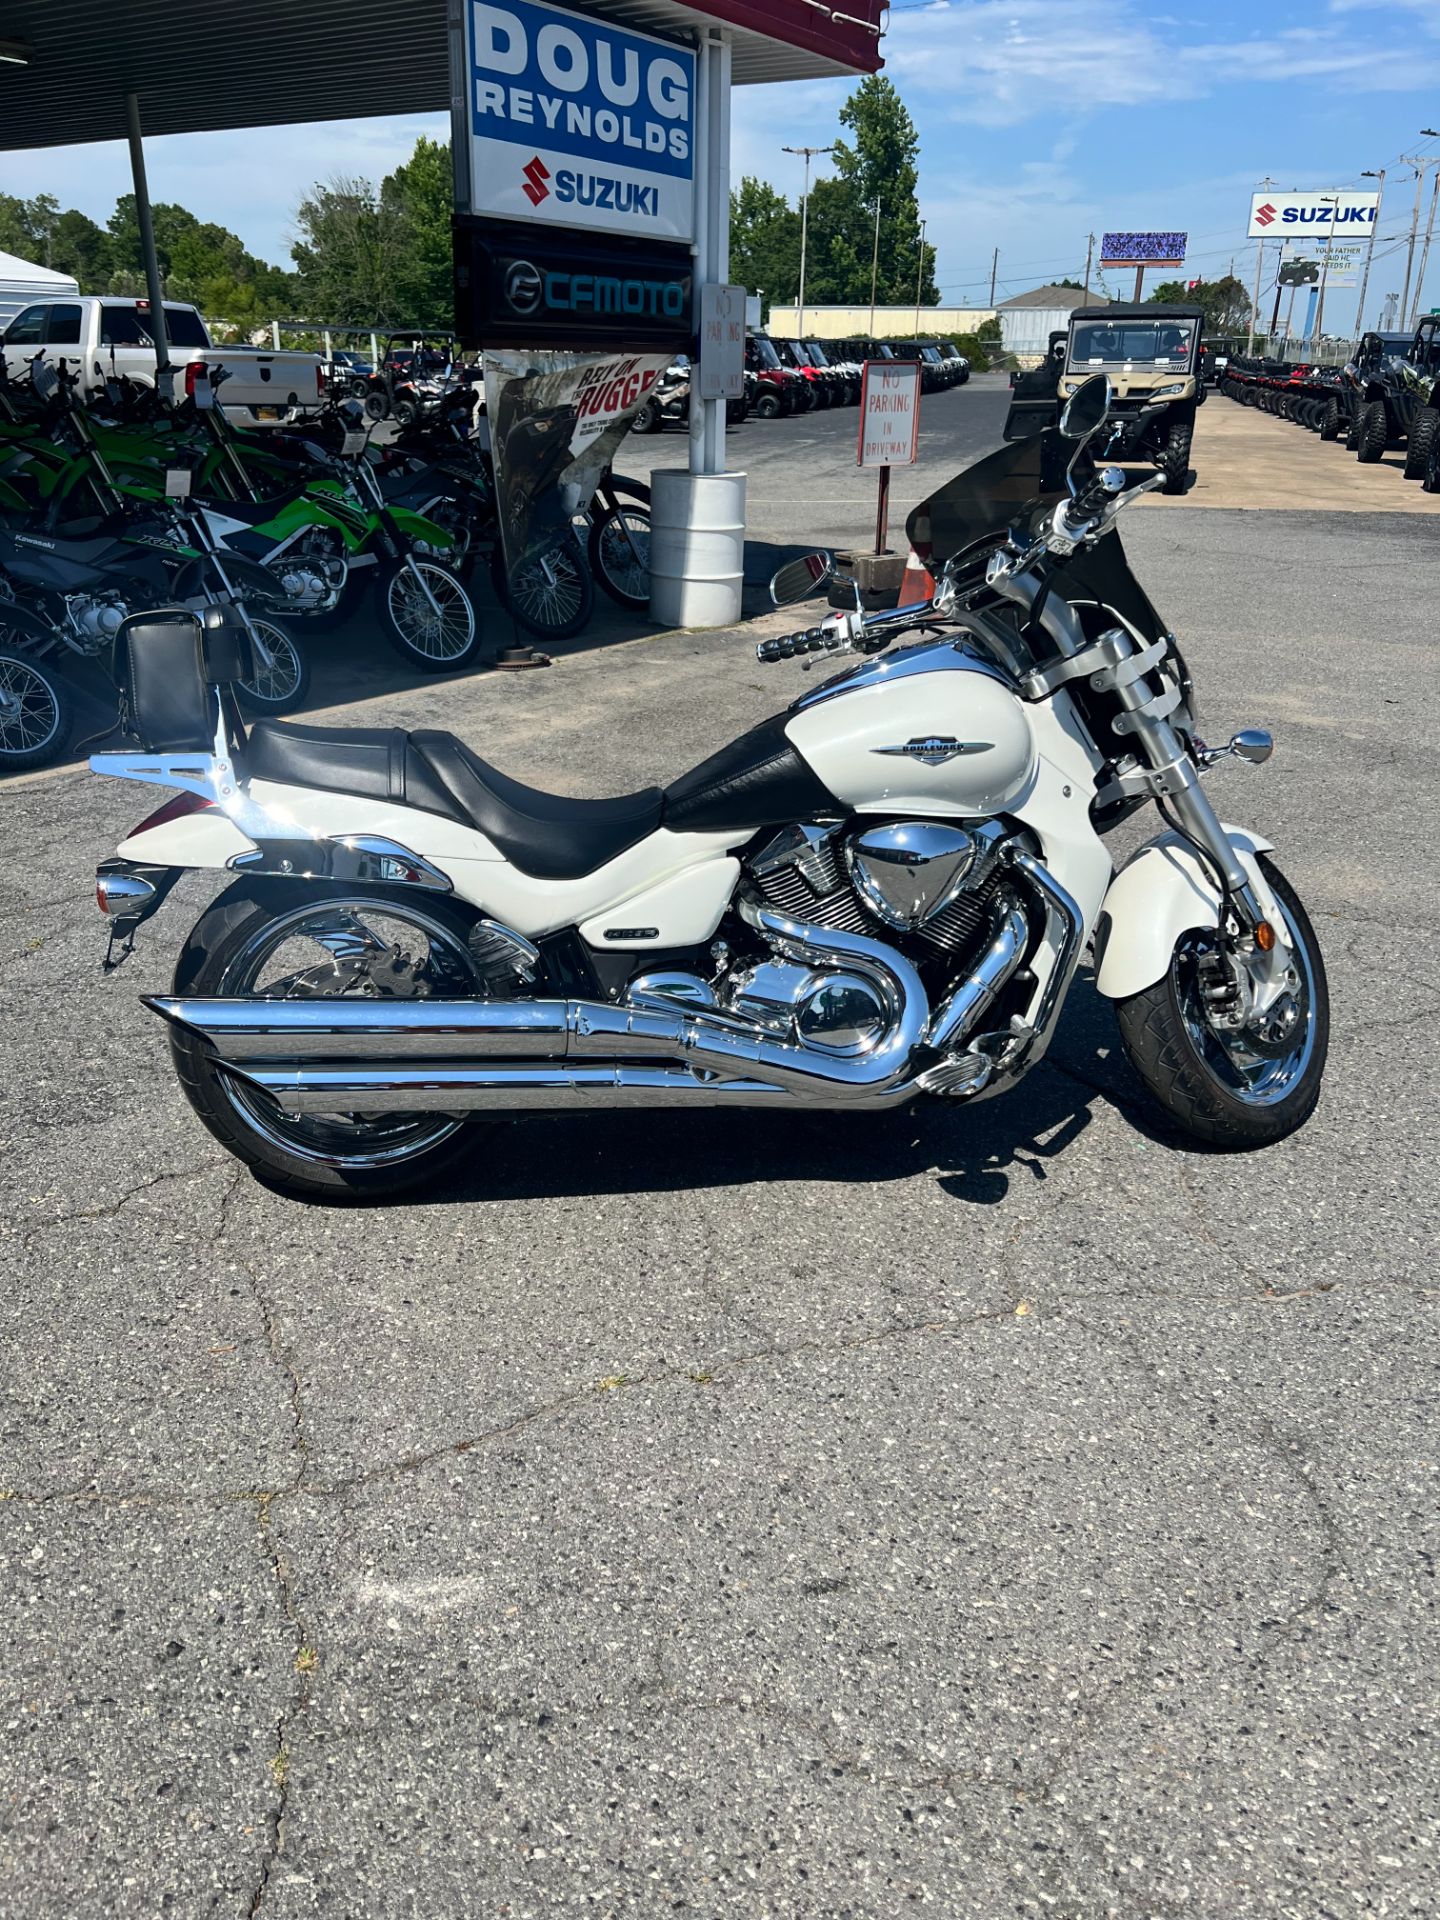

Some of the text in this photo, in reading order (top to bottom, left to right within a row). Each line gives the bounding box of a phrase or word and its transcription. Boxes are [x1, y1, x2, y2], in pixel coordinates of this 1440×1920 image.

[473, 4, 689, 122] DOUG
[475, 79, 689, 160] REYNOLDS
[555, 169, 659, 217] SUZUKI
[1281, 207, 1377, 223] SUZUKI
[1335, 247, 1361, 255] FATHER
[545, 271, 683, 317] CFMOTO
[707, 321, 740, 342] PARNG
[577, 357, 643, 389] RELY ON
[882, 370, 900, 389] NO
[869, 395, 910, 413] PARKING
[883, 421, 892, 436] IN
[866, 441, 908, 457] DRIVEWAY
[15, 534, 56, 550] Kawasaki
[902, 743, 964, 752] BOULEVARD
